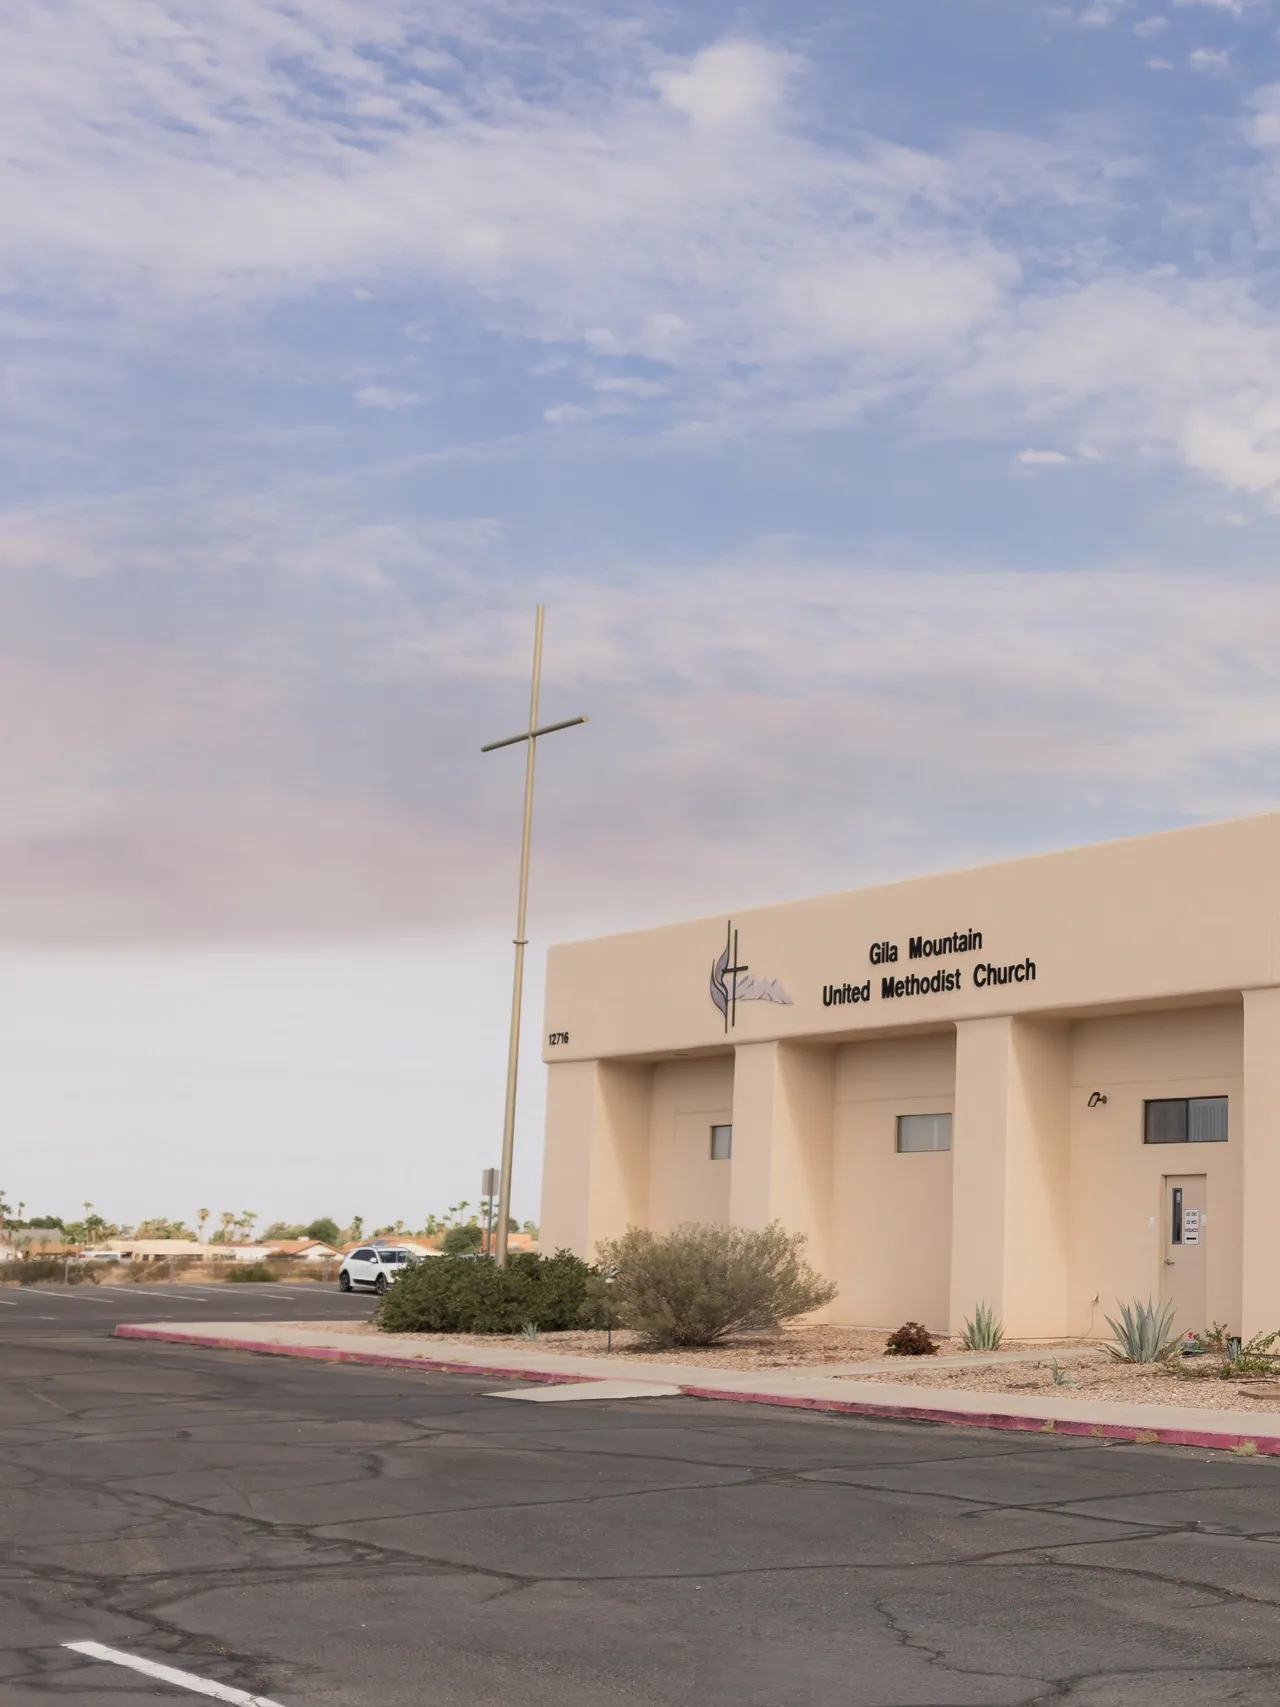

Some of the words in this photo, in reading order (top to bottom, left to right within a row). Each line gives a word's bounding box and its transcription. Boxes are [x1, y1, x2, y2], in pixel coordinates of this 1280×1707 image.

[869, 941, 898, 965] Gila
[908, 928, 983, 960] Mountain
[822, 980, 870, 1007] United
[881, 969, 961, 1000] Methodist
[972, 958, 1036, 988] Church
[548, 1031, 570, 1046] 12716
